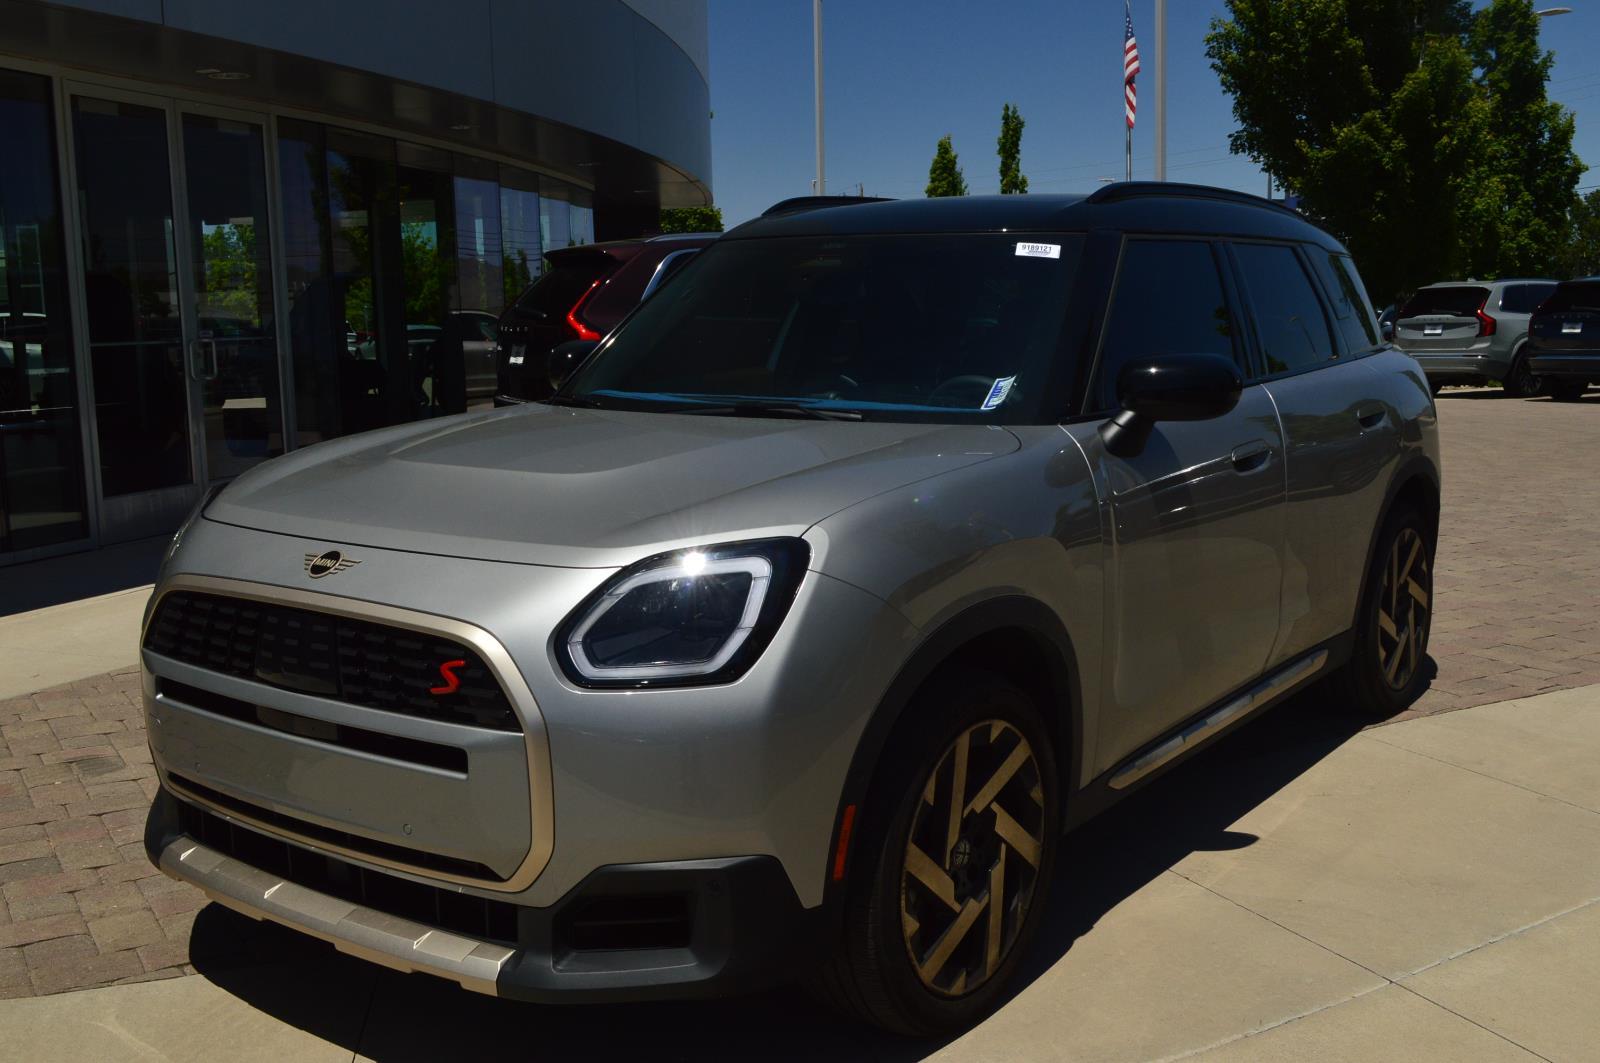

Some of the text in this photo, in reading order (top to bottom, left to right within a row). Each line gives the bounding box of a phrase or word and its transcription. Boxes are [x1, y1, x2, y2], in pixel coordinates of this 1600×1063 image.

[1021, 244, 1052, 252] 9189121
[314, 558, 337, 568] MINI
[430, 659, 466, 695] S
